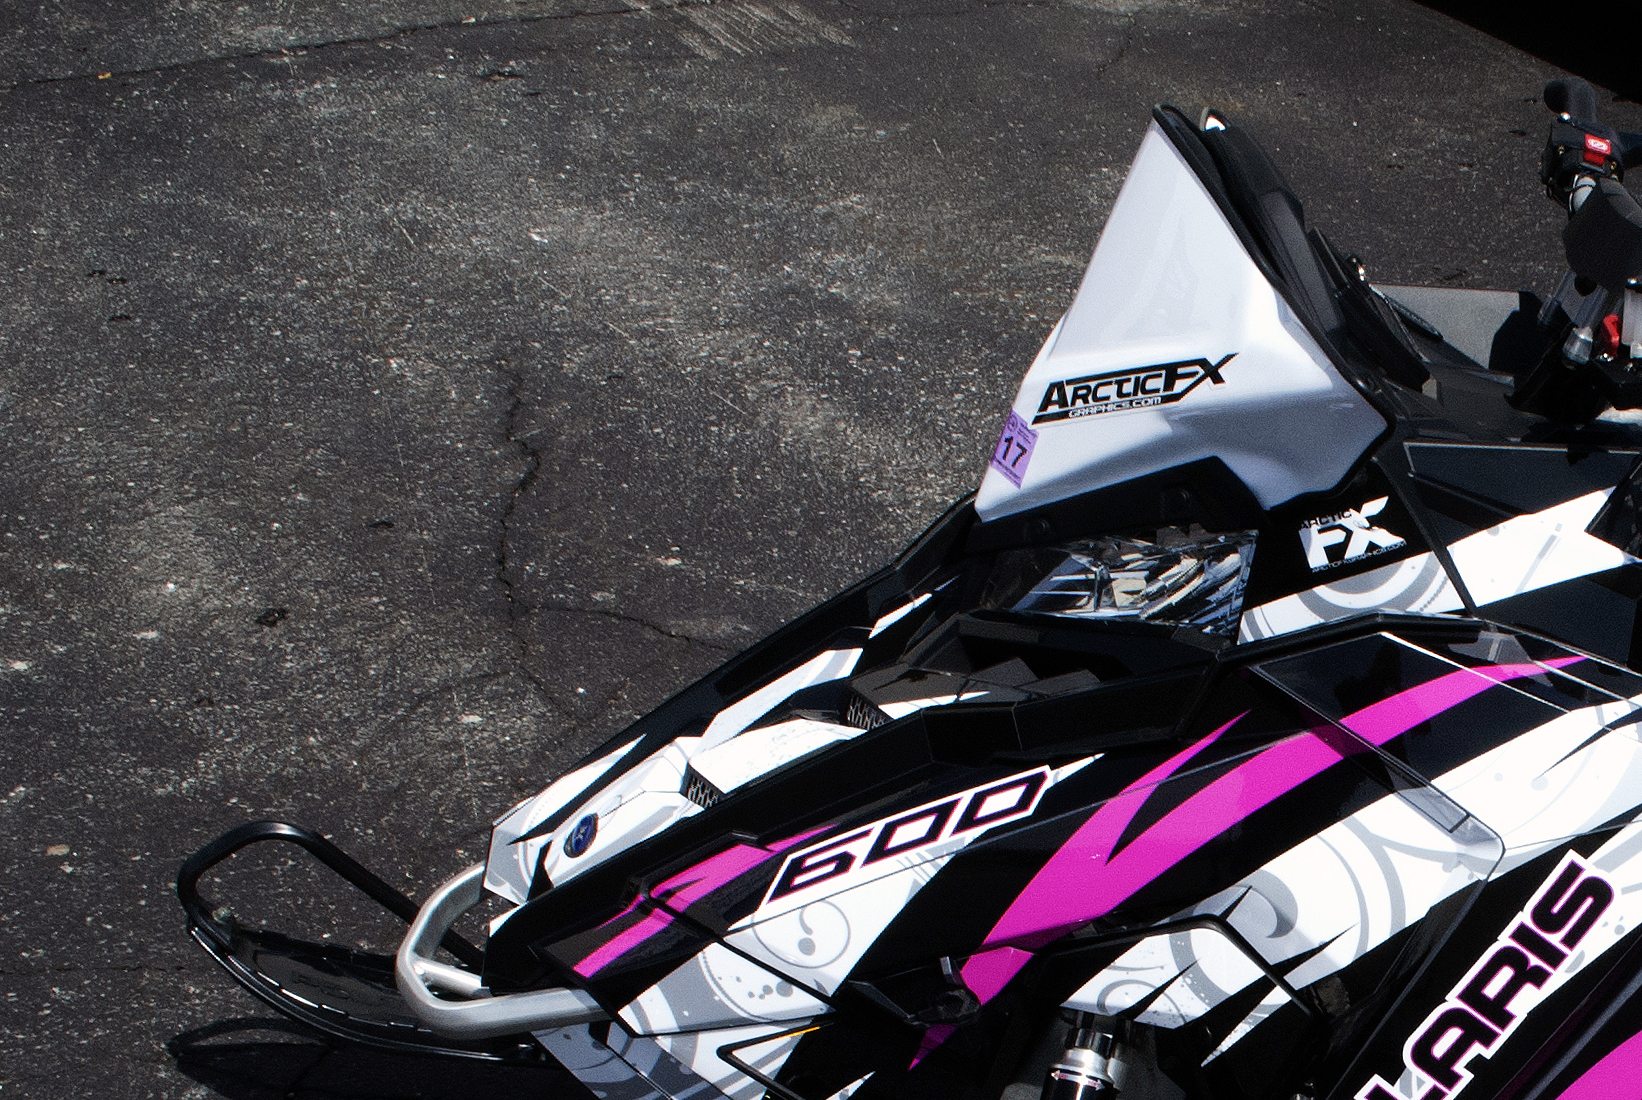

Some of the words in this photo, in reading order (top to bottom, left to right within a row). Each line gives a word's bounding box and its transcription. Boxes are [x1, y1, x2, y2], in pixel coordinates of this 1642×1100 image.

[1002, 436, 1028, 469] 17
[1299, 496, 1405, 569] FX
[766, 768, 1050, 903] 600
